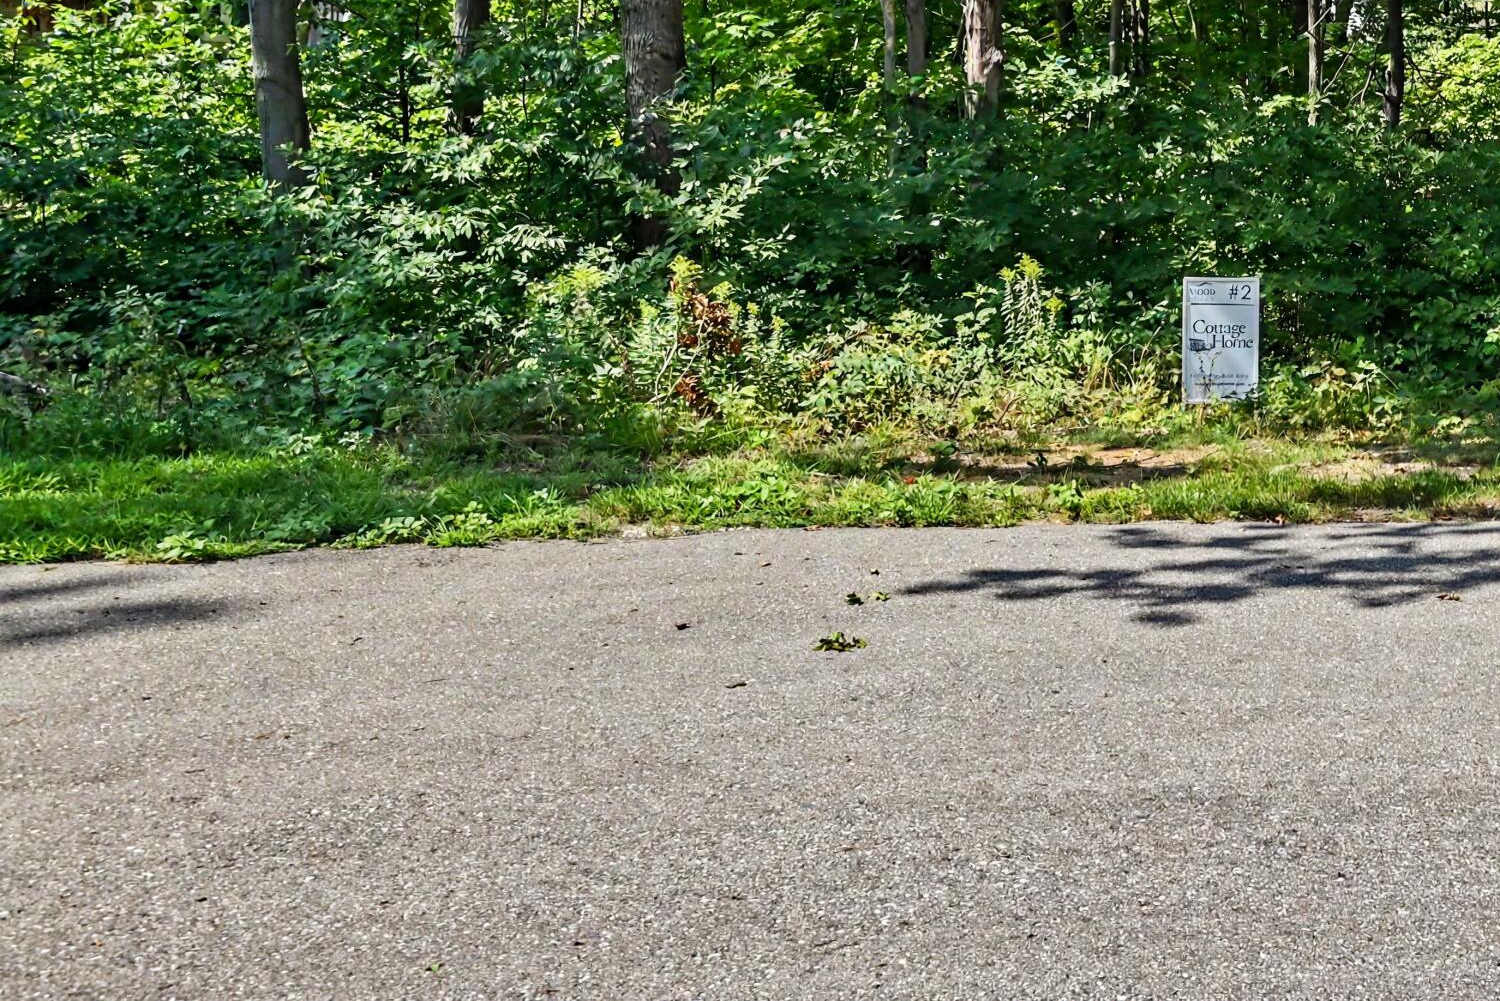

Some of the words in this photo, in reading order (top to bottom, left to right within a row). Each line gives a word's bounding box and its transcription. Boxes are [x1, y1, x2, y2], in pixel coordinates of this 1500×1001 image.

[1229, 284, 1251, 300] #2
[1193, 320, 1247, 338] Cottage
[1212, 335, 1254, 349] Home
